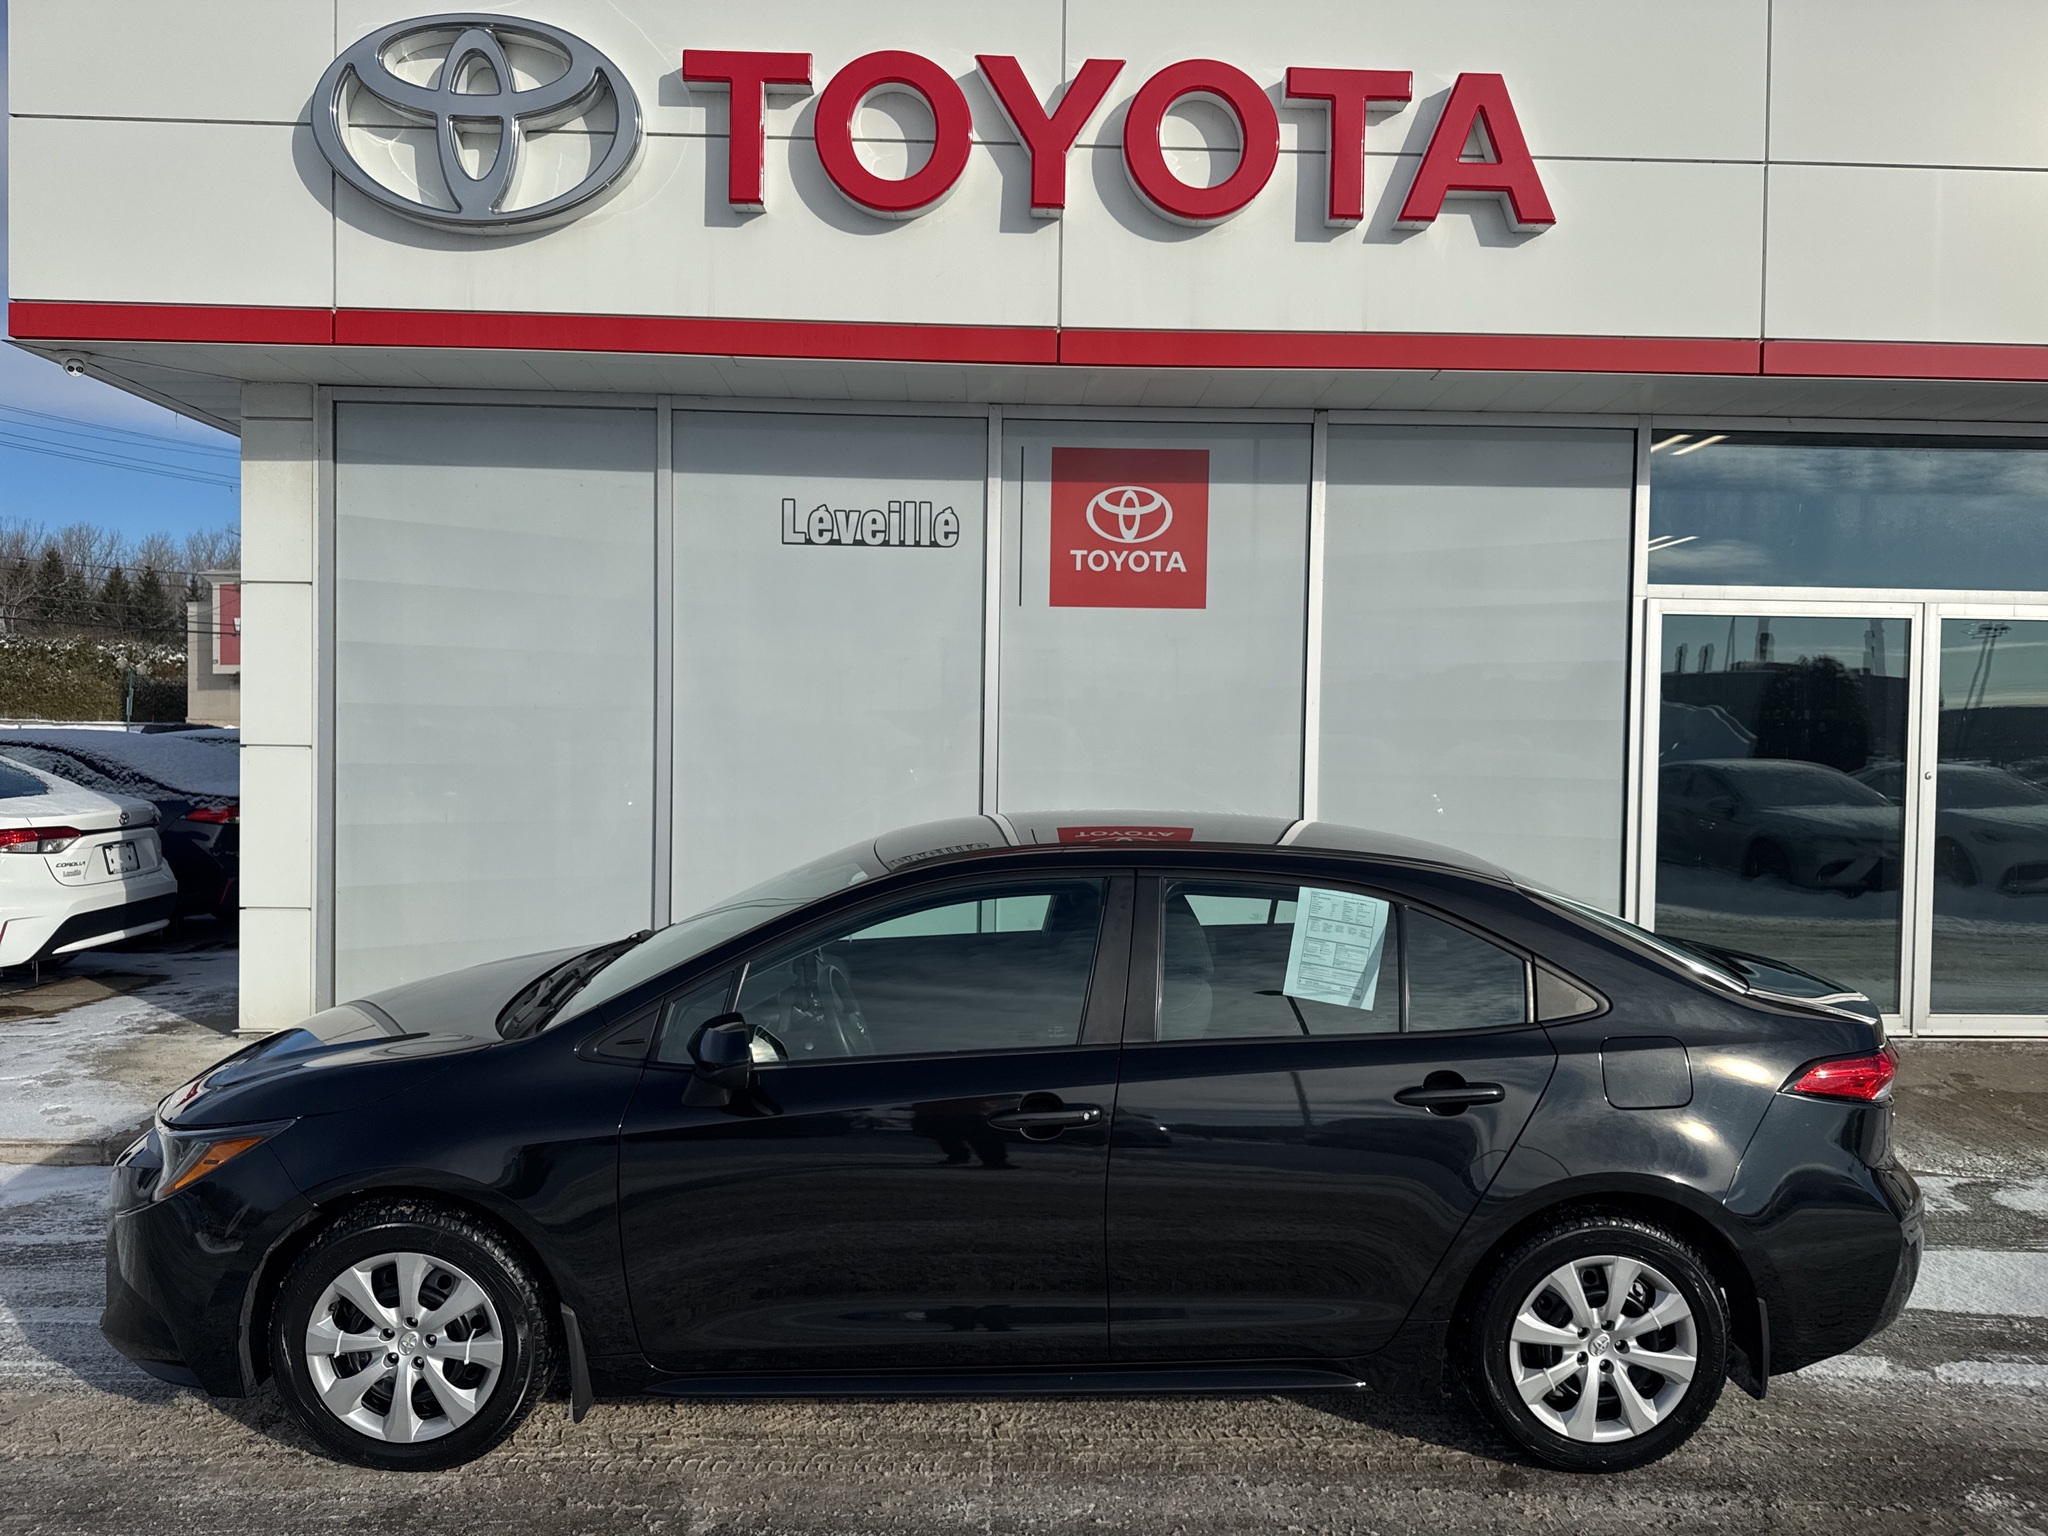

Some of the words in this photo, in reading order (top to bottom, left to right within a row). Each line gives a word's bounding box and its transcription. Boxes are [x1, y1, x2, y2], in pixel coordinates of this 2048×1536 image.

[682, 49, 1556, 232] TOYOTA
[782, 498, 959, 548] Léveillé
[1070, 549, 1187, 573] TOYOTA
